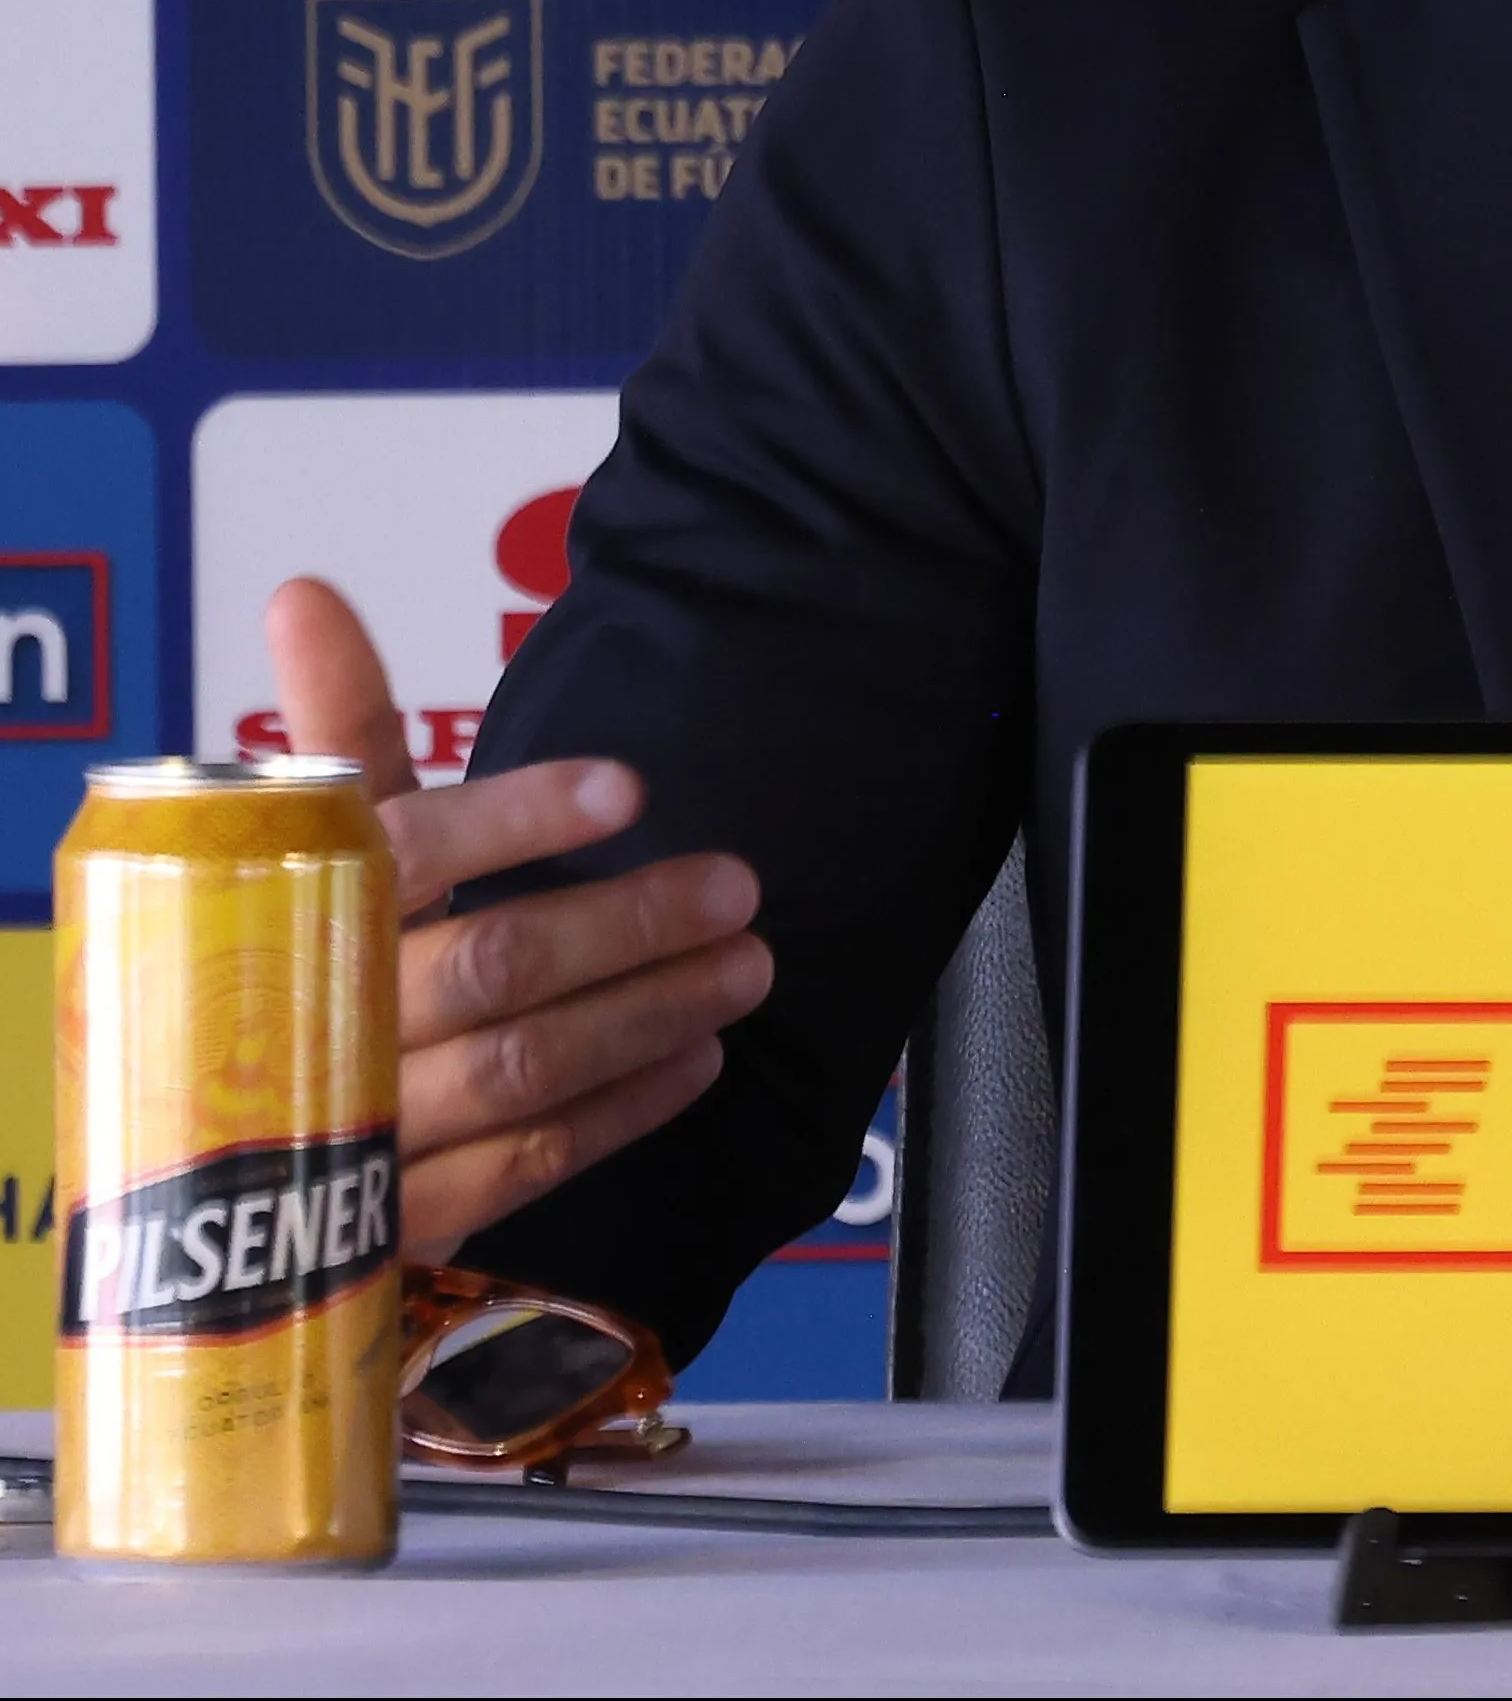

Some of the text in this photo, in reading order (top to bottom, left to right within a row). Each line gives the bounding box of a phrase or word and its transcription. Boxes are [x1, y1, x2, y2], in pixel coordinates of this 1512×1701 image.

[594, 38, 806, 87] FEDERA
[595, 157, 660, 200] DE
[78, 1157, 390, 1322] PILSENER
